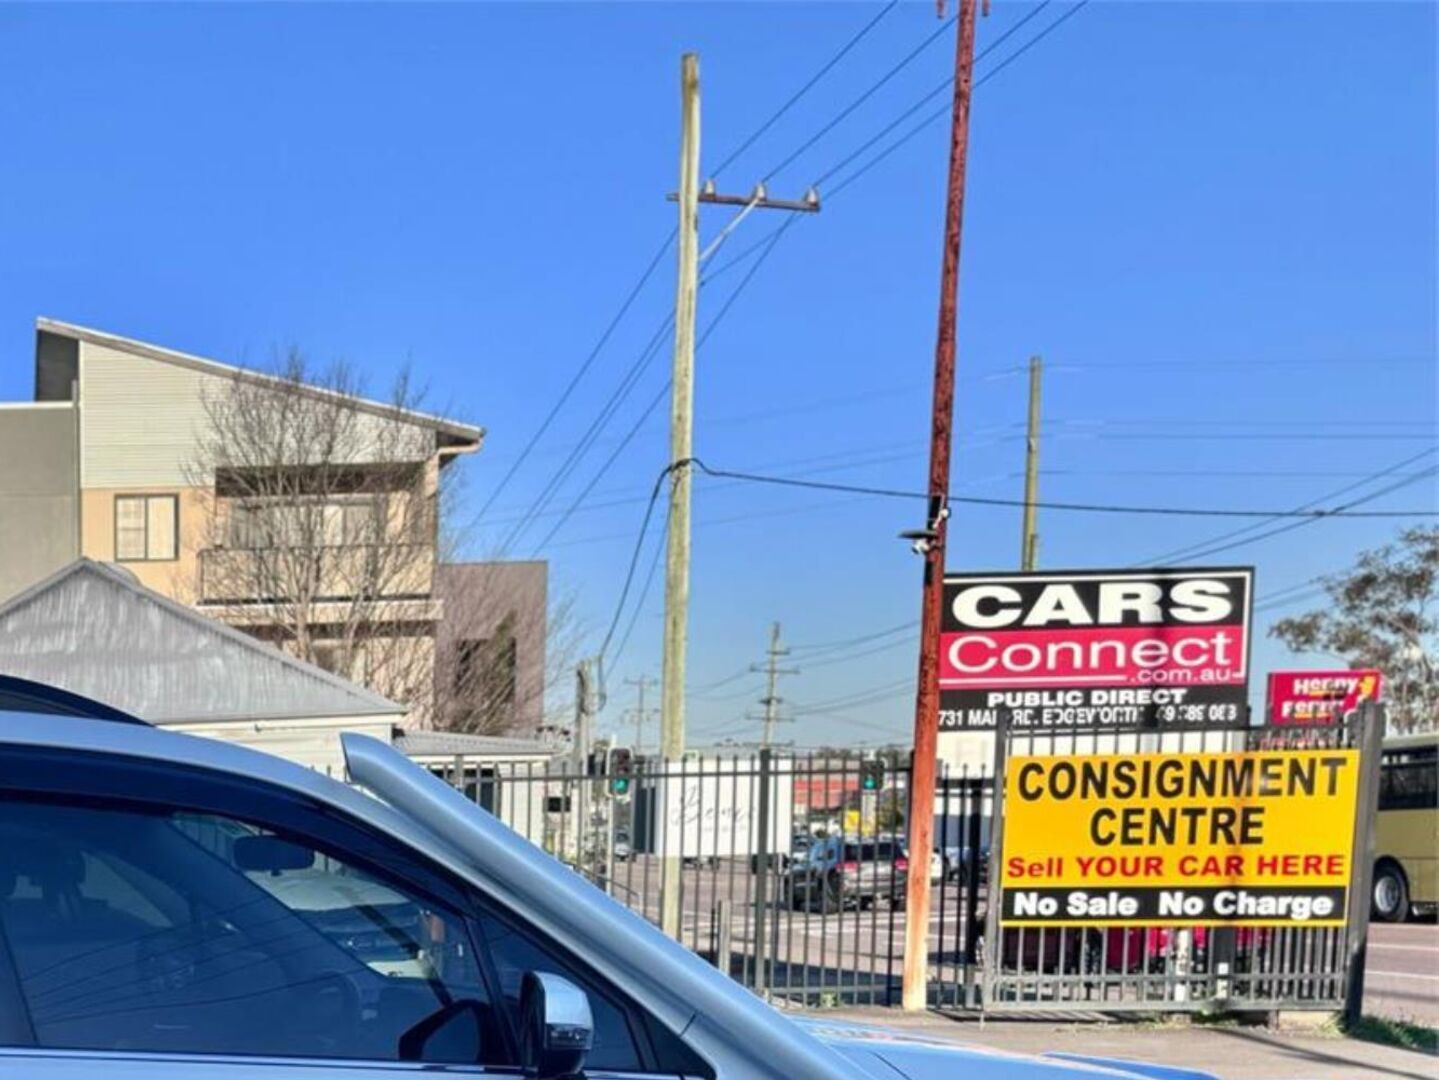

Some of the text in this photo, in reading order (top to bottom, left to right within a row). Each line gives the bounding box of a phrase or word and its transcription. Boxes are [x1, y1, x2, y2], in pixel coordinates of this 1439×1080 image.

[952, 580, 1233, 628] CARS
[948, 632, 1233, 673] Connect
[1129, 668, 1231, 683] .com.au
[987, 688, 1188, 708] PUBLIC DIRECT
[938, 709, 963, 727] 731
[967, 708, 997, 726] MAI
[1017, 757, 1347, 801] CONSIGNMENT
[1090, 806, 1265, 846] CENTRE
[1007, 853, 1345, 878] Sell YOUR CAR HERE
[1013, 890, 1335, 920] No Sale No Charge
